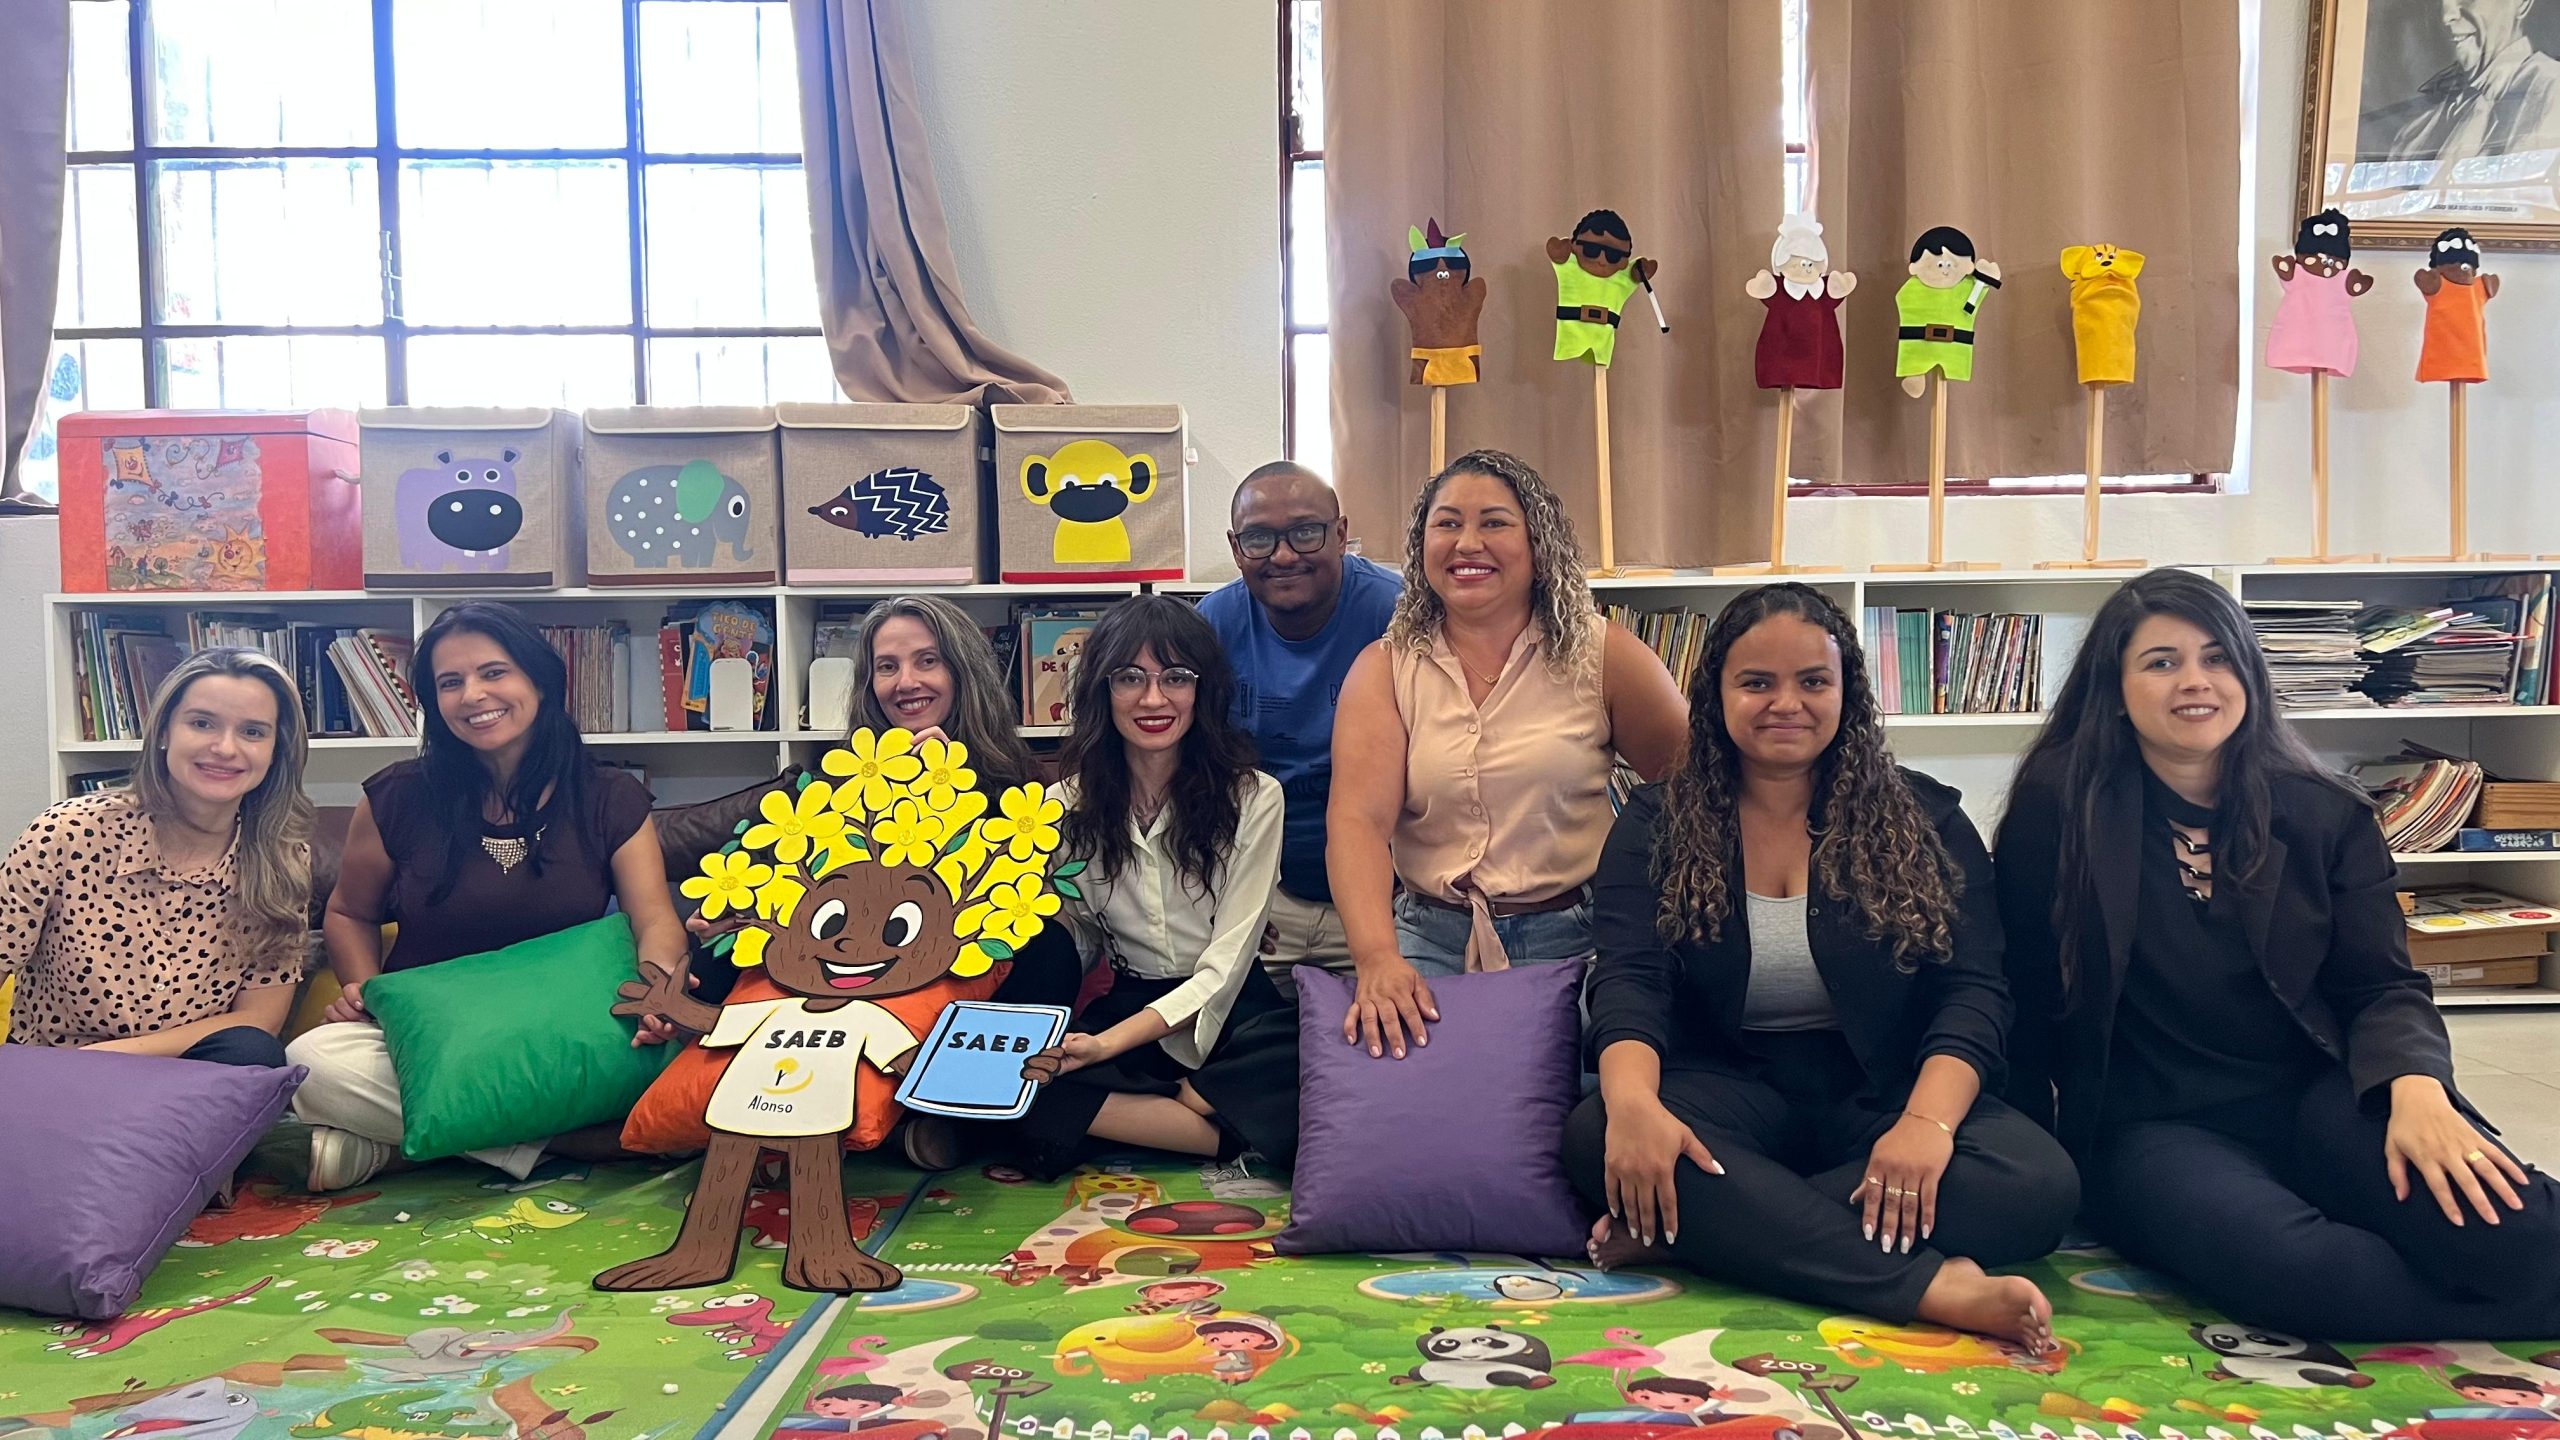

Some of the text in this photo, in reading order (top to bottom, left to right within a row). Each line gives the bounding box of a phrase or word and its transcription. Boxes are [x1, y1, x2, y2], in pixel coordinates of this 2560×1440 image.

[1042, 661, 1057, 672] DE
[765, 1029, 847, 1049] SAEB
[947, 1031, 1031, 1053] SAEB
[748, 1095, 793, 1114] Alonso
[970, 1364, 1023, 1378] ZOO
[1759, 1359, 1817, 1371] ZOO
